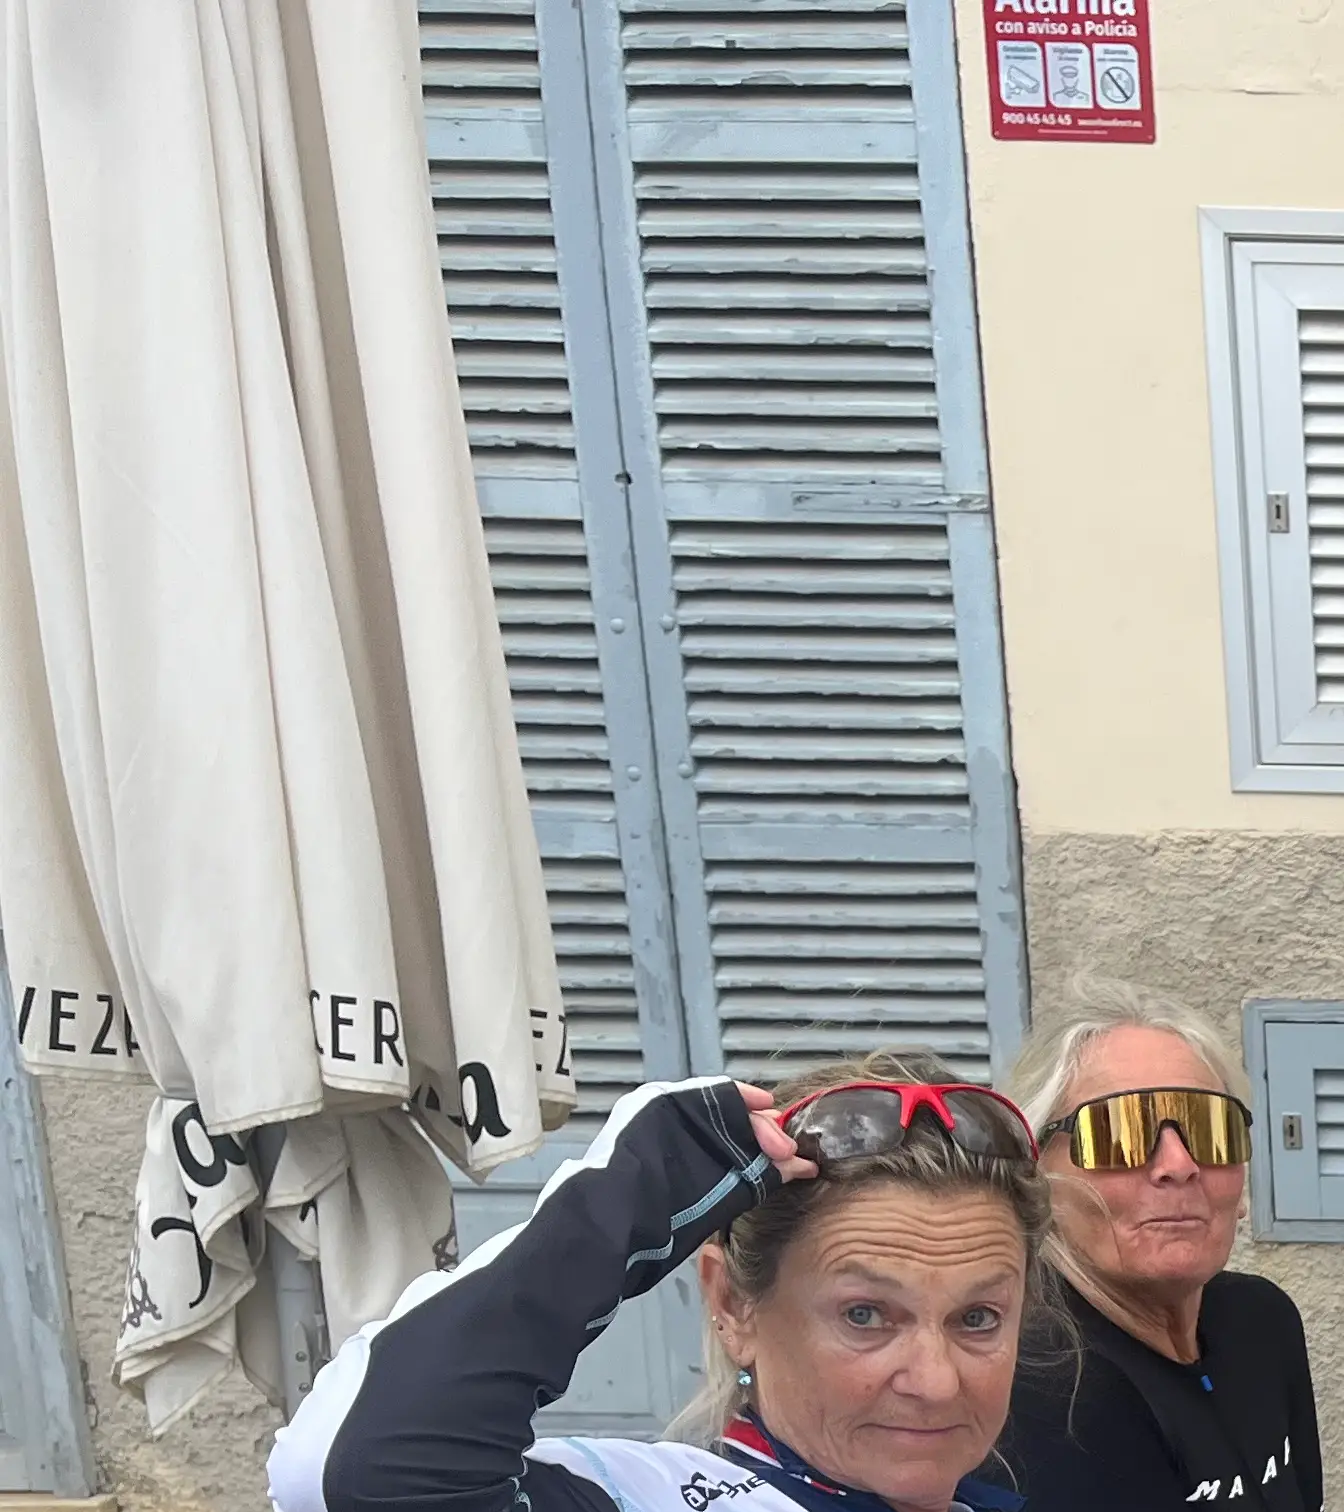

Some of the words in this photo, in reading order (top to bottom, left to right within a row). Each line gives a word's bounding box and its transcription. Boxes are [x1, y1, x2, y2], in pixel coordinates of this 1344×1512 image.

[995, 20, 1023, 34] con
[1026, 18, 1068, 36] aviso
[1071, 24, 1082, 35] a
[1085, 20, 1137, 37] Policía
